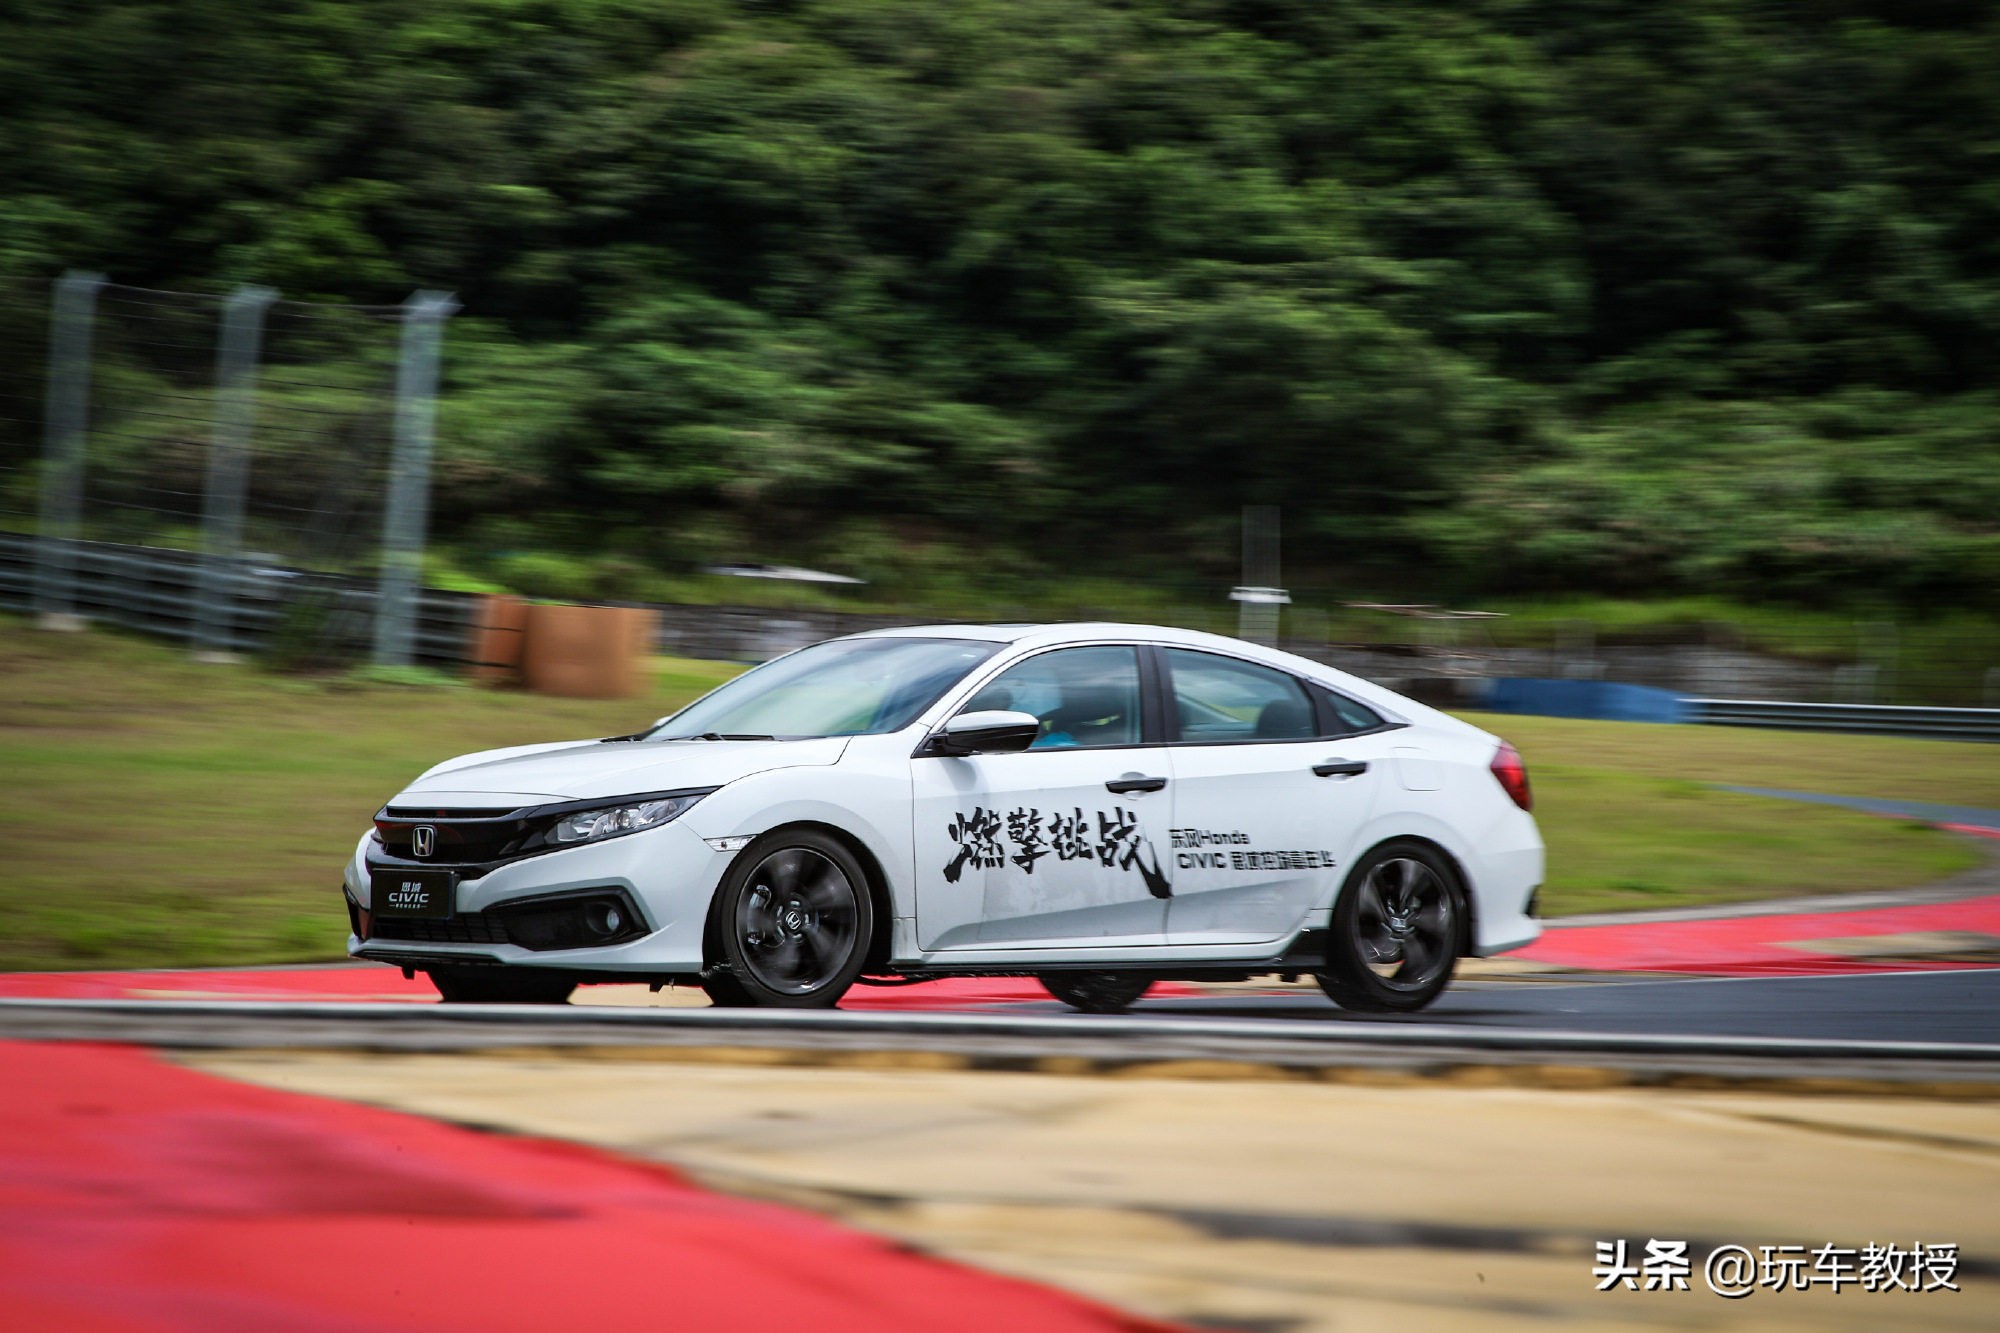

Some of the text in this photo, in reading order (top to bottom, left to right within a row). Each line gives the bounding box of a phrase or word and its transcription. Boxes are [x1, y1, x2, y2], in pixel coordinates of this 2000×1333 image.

[943, 806, 1172, 898] 燃擎挑战
[1177, 852, 1227, 869] CIVIC
[388, 893, 430, 903] CIVIC
